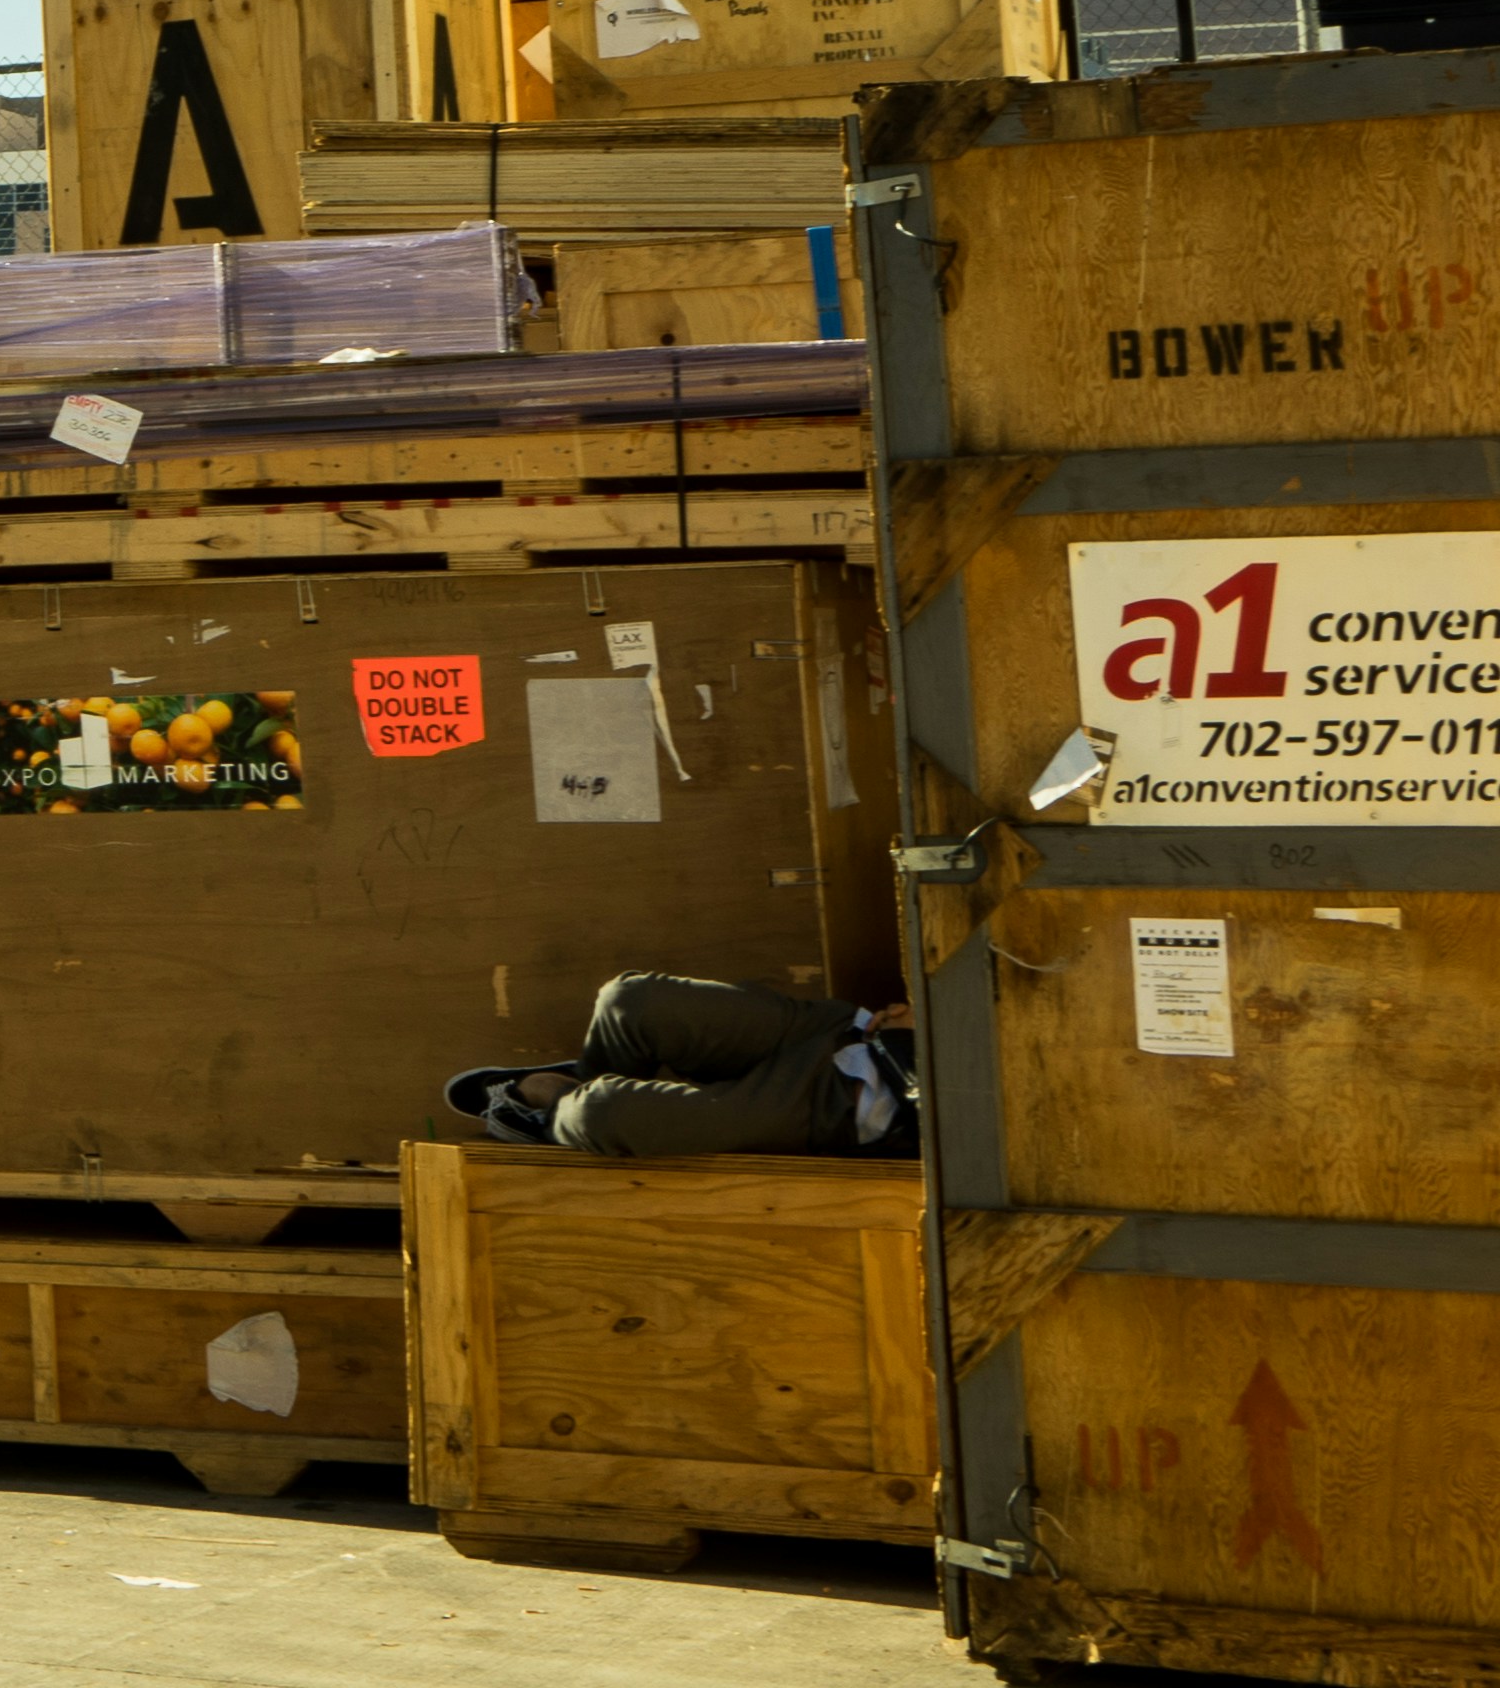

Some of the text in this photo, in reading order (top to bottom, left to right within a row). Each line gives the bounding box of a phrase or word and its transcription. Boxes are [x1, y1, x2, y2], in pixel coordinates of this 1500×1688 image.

[813, 11, 845, 22] INC.
[824, 30, 883, 43] RENTAL
[814, 47, 896, 62] PROPERTY
[120, 19, 265, 245] A
[1366, 263, 1473, 332] UP
[1109, 318, 1345, 380] BOWER
[68, 395, 103, 414] EMPTY
[1102, 562, 1288, 700] a1
[1308, 609, 1500, 643] conven
[612, 633, 642, 644] LAX
[370, 668, 463, 691] DO NOT
[1304, 651, 1500, 696] service
[367, 696, 469, 718] DOUBLE
[380, 724, 461, 745] STACK
[117, 761, 290, 785] MARKETING
[1113, 770, 1500, 803] a1conventionservic
[1077, 1423, 1182, 1493] UP
